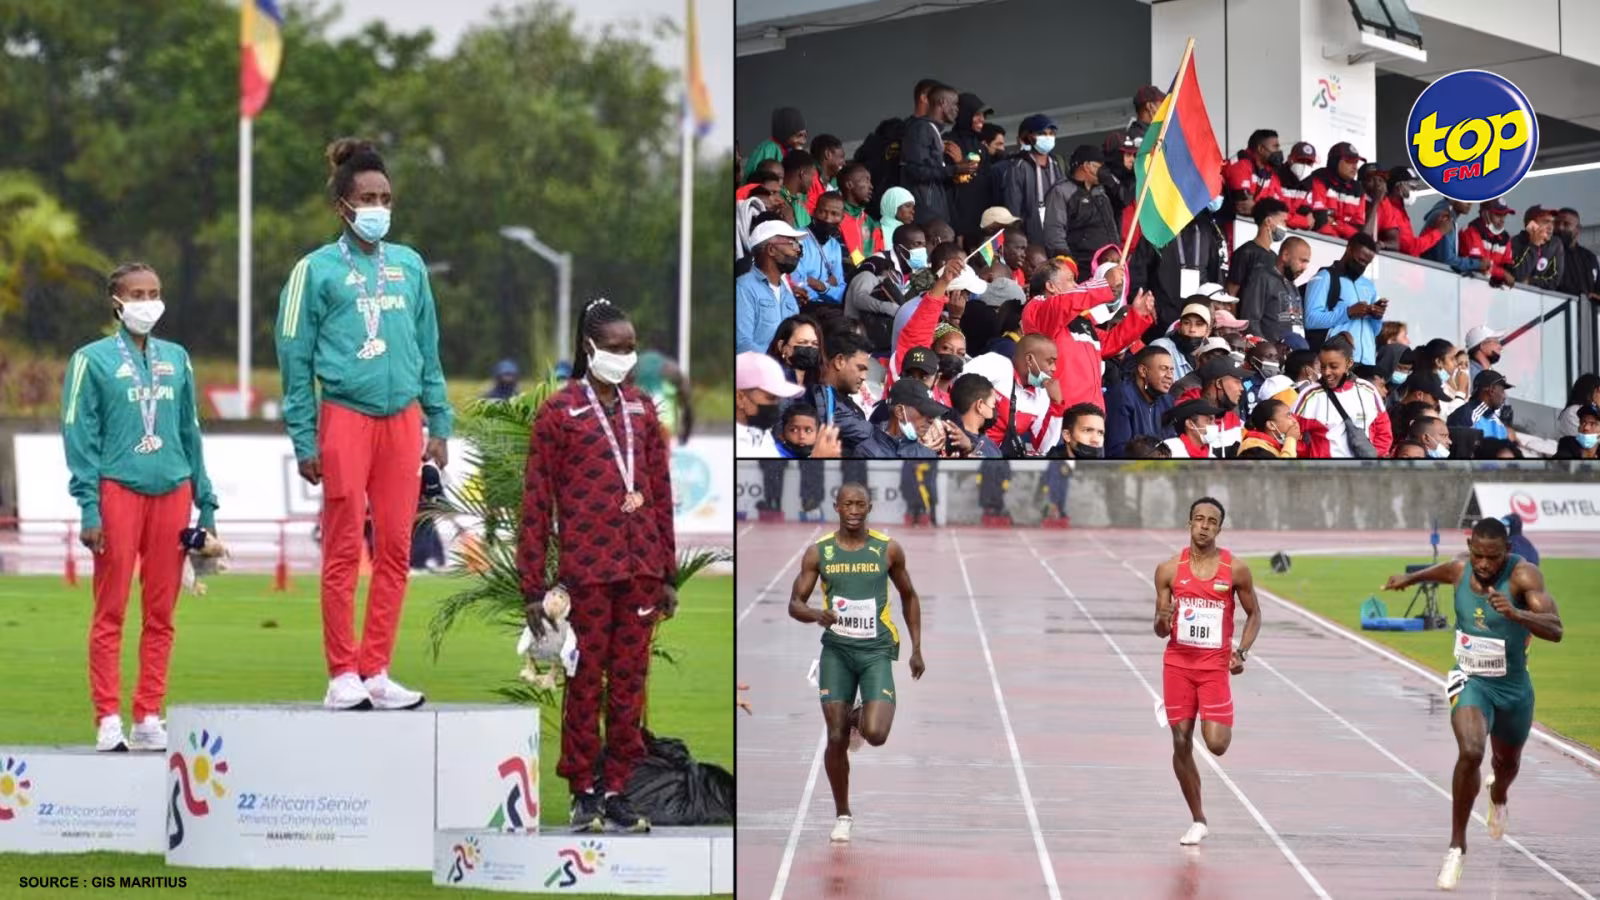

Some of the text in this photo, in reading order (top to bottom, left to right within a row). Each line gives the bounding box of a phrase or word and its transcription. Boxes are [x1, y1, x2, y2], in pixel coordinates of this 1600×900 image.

[1541, 498, 1600, 516] EMTEL
[825, 562, 880, 574] SOUTH AFRICA
[1176, 597, 1226, 609] MAURITIUS
[838, 616, 875, 630] AMBILE
[1190, 625, 1210, 639] BIBI
[260, 795, 316, 811] African
[317, 793, 368, 812] Senior
